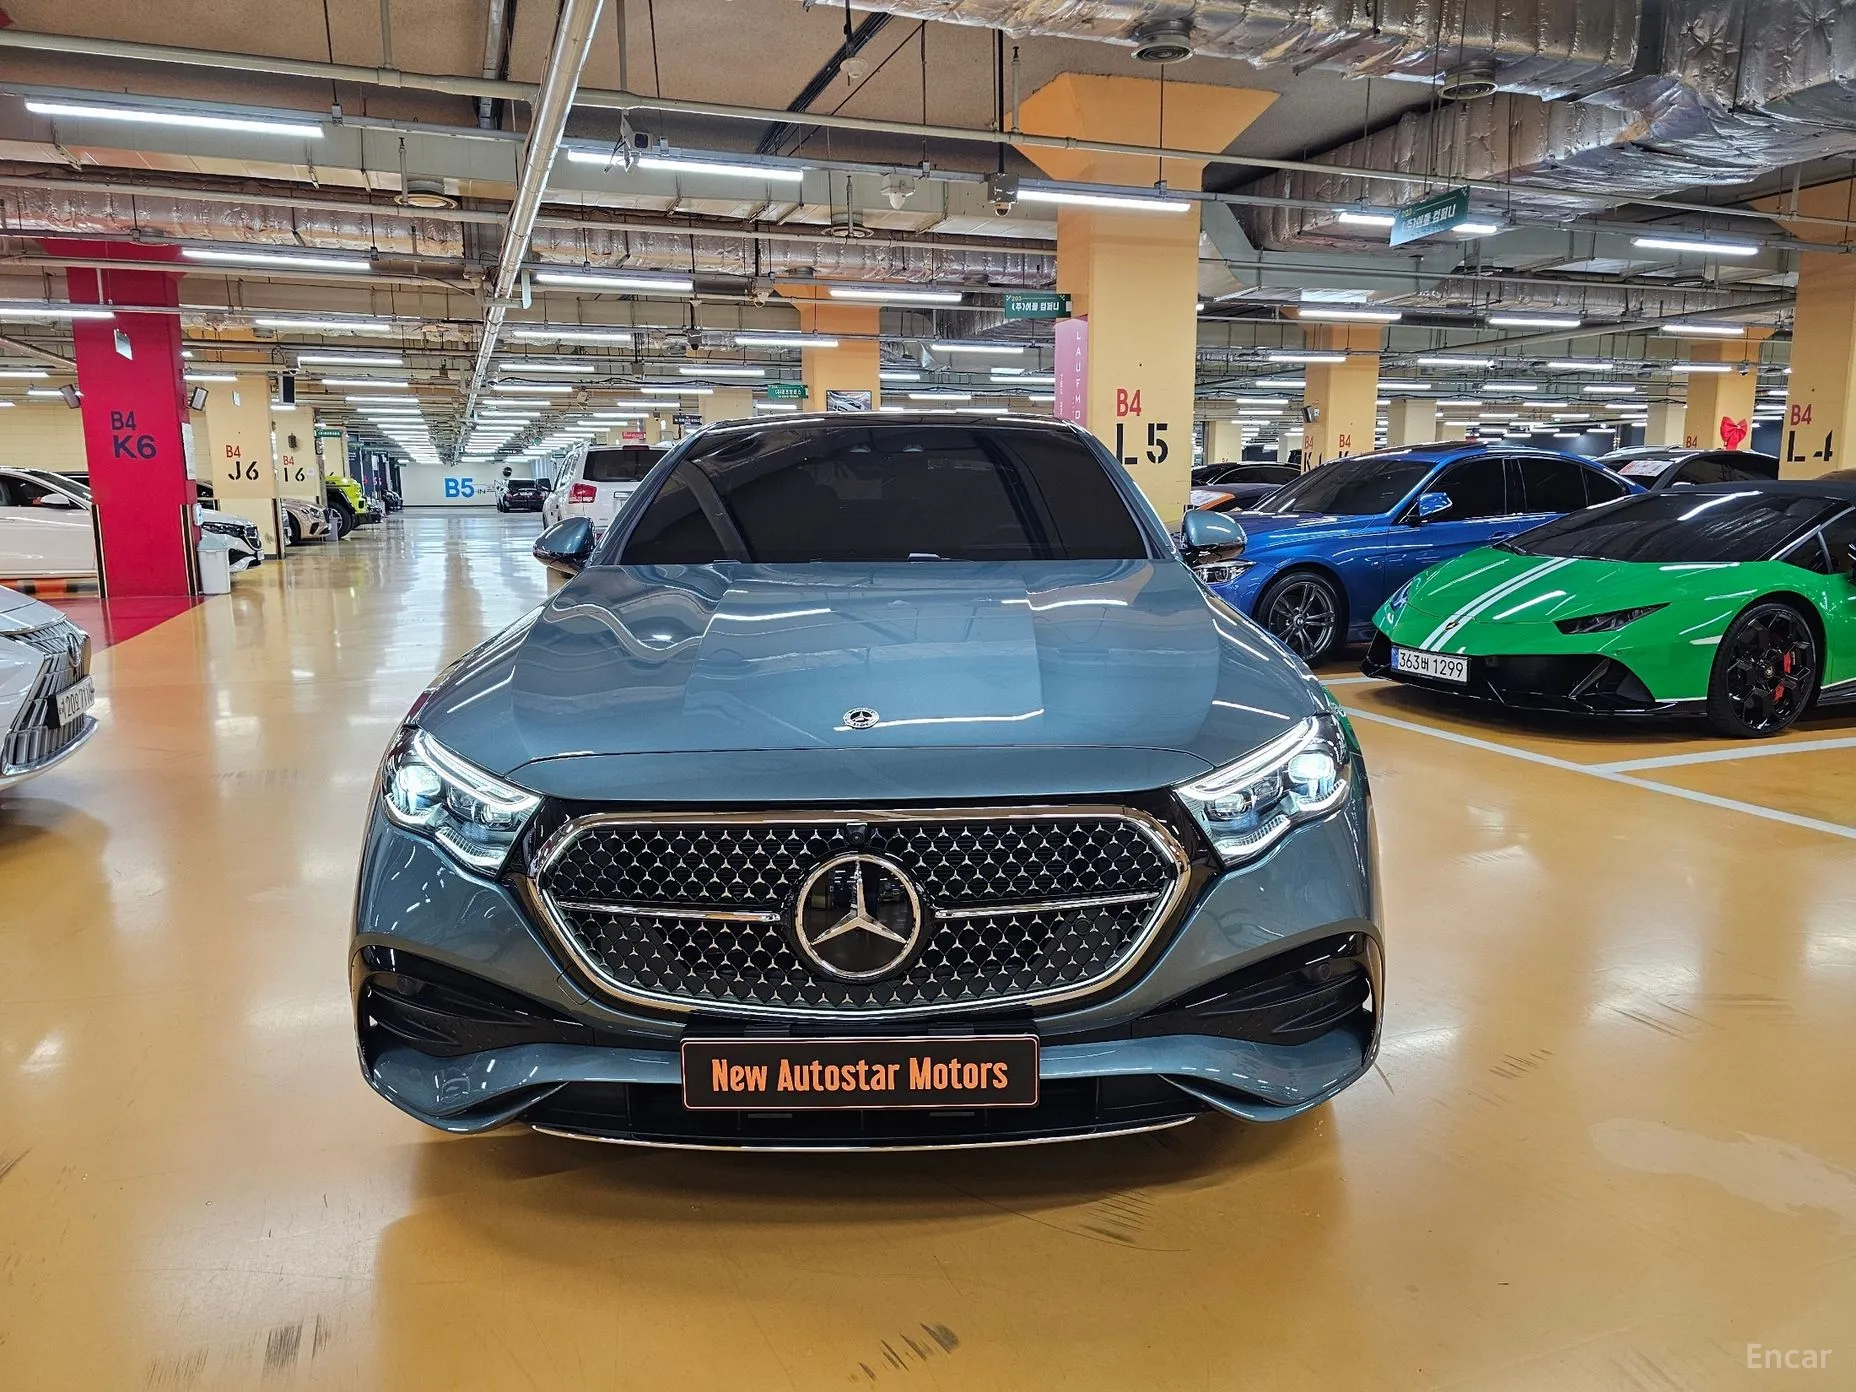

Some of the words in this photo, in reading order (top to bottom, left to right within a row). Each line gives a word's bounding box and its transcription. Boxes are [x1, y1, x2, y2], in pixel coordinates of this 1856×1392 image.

[1116, 388, 1142, 417] B4
[110, 411, 137, 431] B4
[1790, 404, 1812, 426] B4
[113, 434, 157, 459] K6
[225, 444, 241, 458] B4
[1304, 435, 1314, 450] B4
[1339, 434, 1351, 448] B4
[1686, 435, 1698, 448] B4
[283, 455, 295, 465] B4
[228, 461, 259, 480] J6
[444, 477, 475, 498] B5
[1433, 658, 1464, 678] 1299
[711, 1058, 768, 1092] New
[776, 1058, 900, 1091] Autostar
[909, 1056, 1008, 1090] Motors
